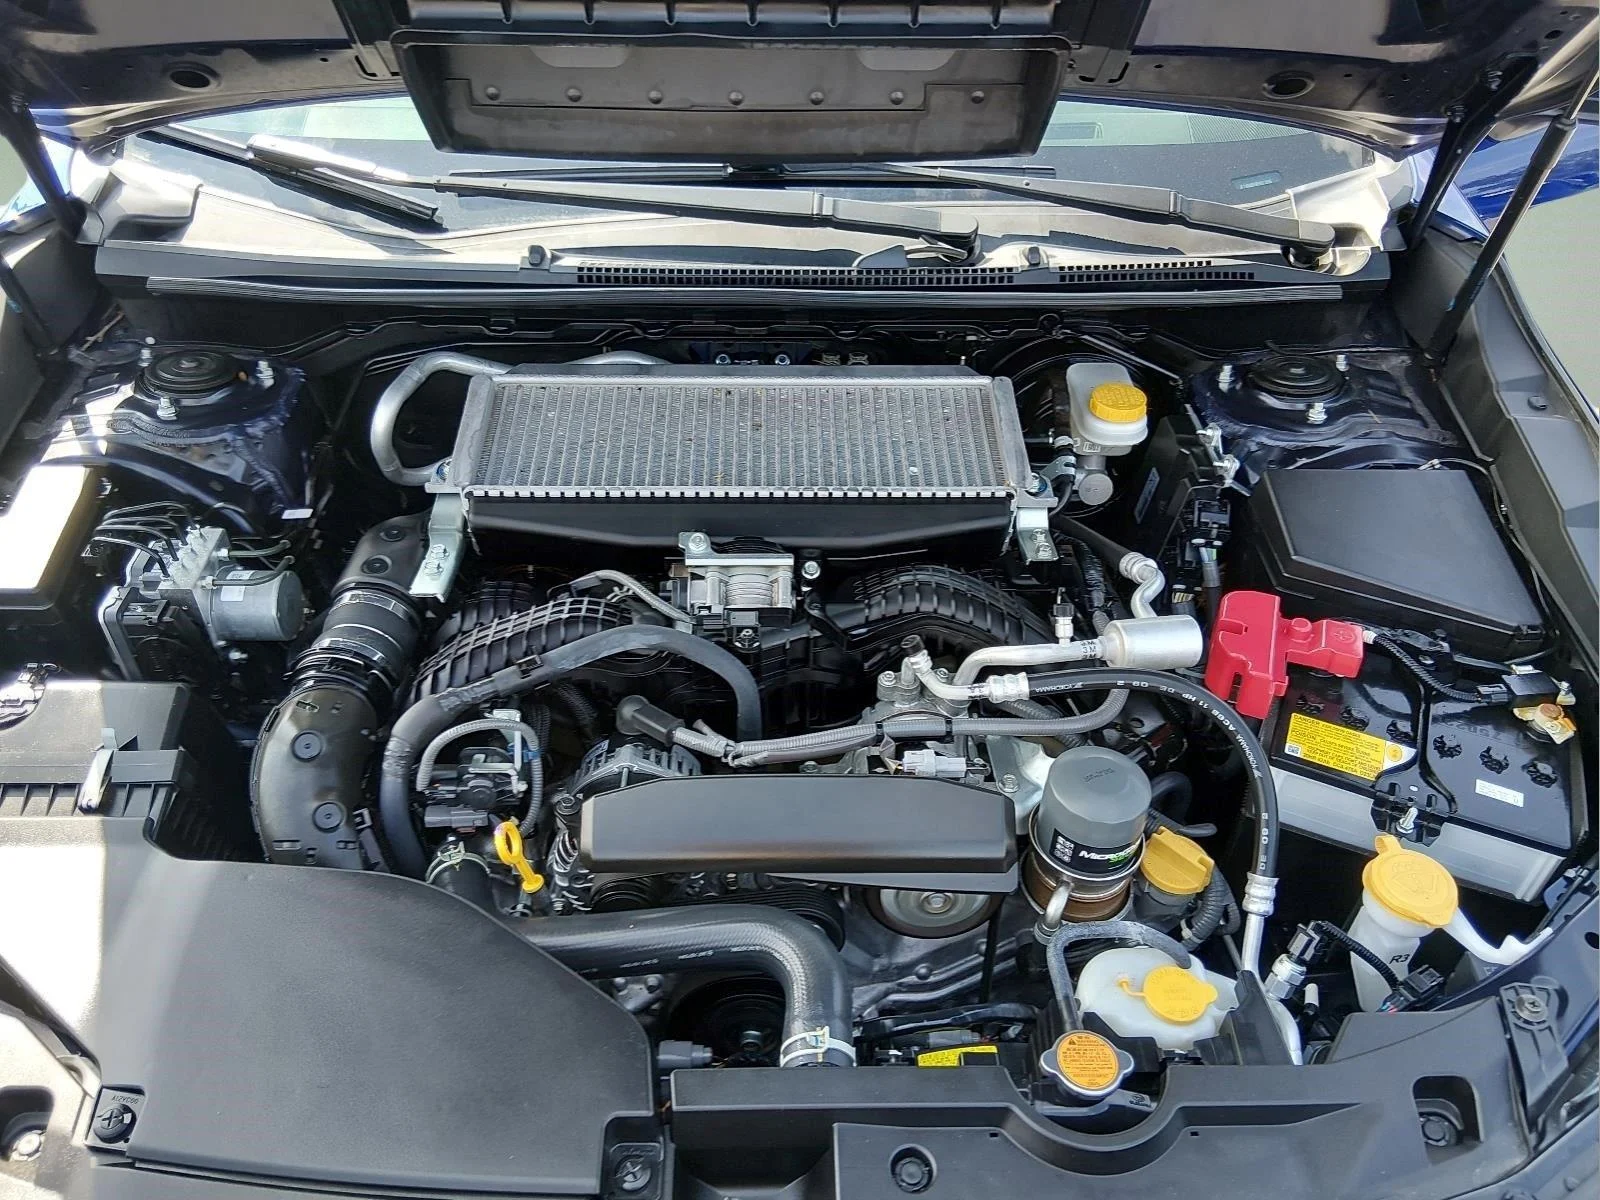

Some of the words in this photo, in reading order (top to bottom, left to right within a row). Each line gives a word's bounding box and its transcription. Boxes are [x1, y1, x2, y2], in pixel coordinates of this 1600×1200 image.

[1182, 693, 1197, 702] HP
[1235, 733, 1259, 769] YOKOHAMA
[1389, 953, 1410, 965] R3
